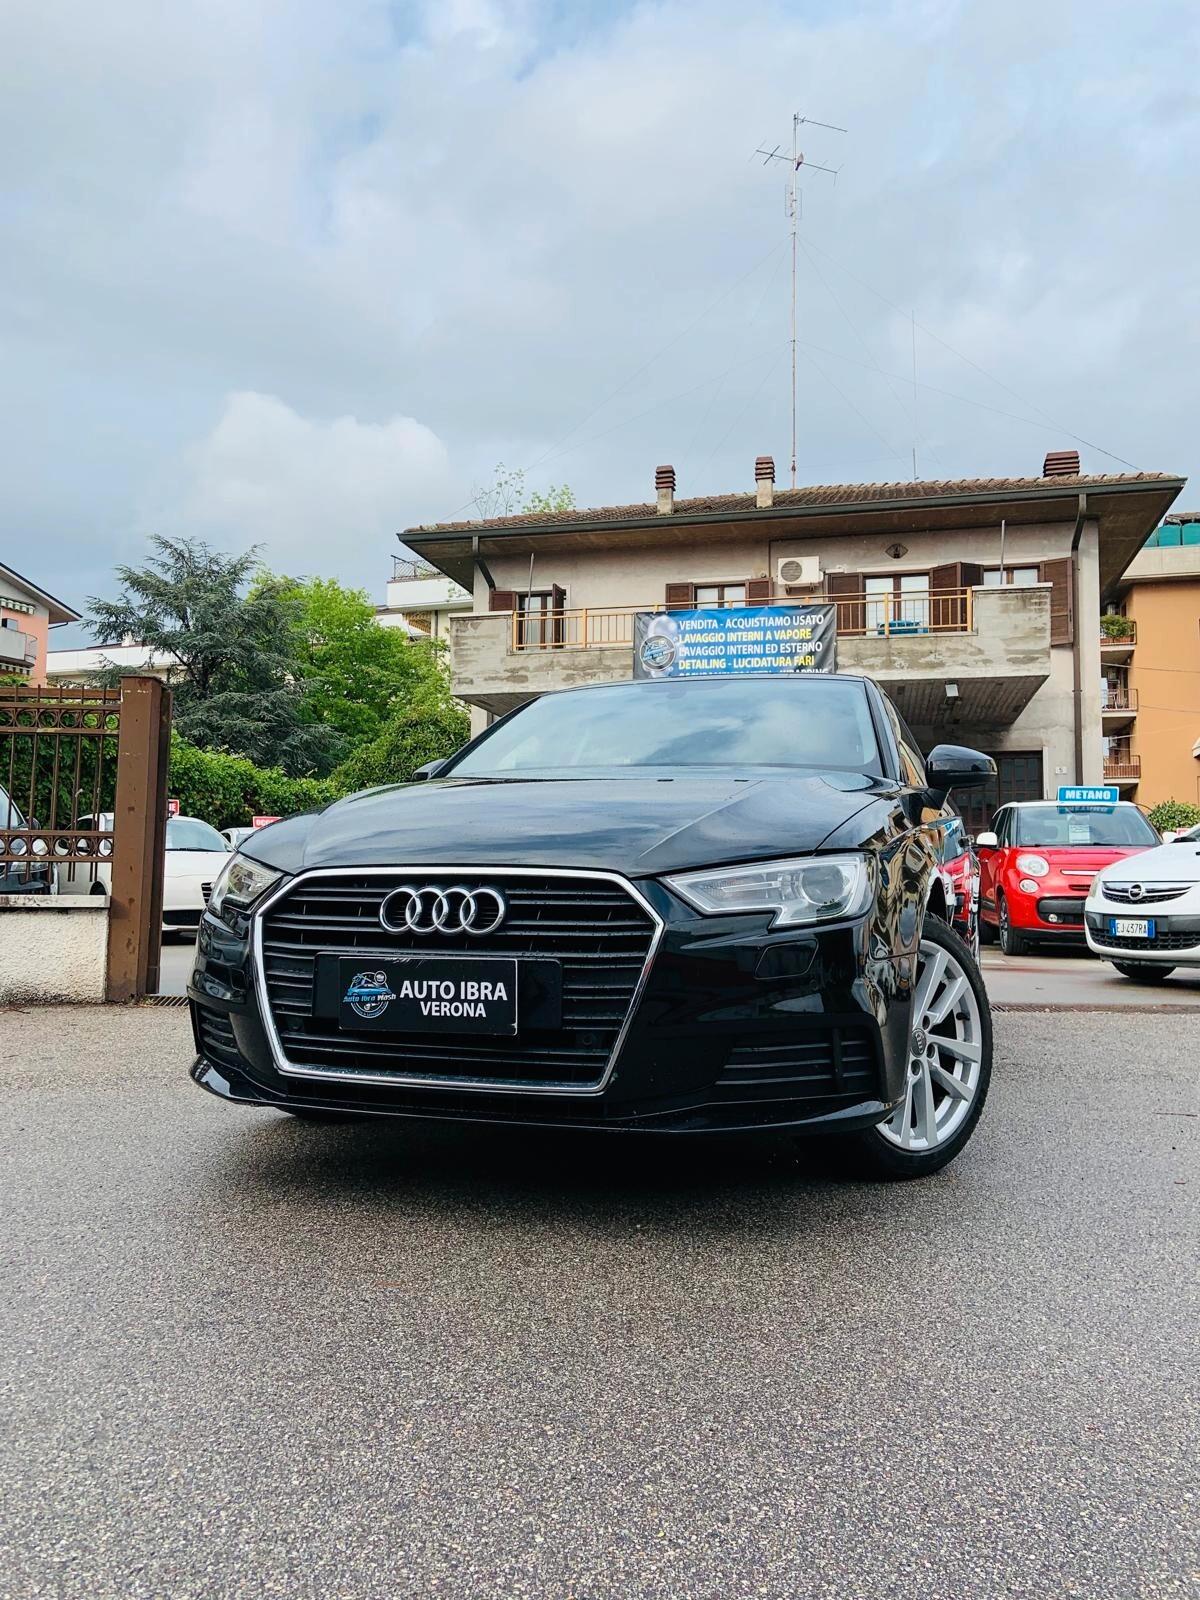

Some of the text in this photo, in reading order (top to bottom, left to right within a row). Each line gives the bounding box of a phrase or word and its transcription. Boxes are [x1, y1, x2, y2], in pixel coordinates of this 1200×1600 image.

[679, 619, 718, 630] VENDITA
[725, 616, 791, 629] ACQUISTIAMO
[793, 614, 824, 626] USATO
[679, 628, 812, 644] LAVAGGIO INTERNI A VAPORE
[679, 645, 725, 657] LAVAGGIO
[727, 643, 764, 655] INTERNI
[766, 643, 778, 654] ED
[780, 641, 823, 653] ESTERNO
[679, 658, 726, 670] DETAILING
[733, 656, 792, 668] LUCIDATURA
[794, 655, 815, 666] FARI
[1065, 789, 1111, 800] METANO
[343, 995, 360, 1003] Auto
[377, 993, 397, 1001] Wash
[400, 980, 508, 1001] AUTO IBRA
[420, 1001, 487, 1018] VERONA
